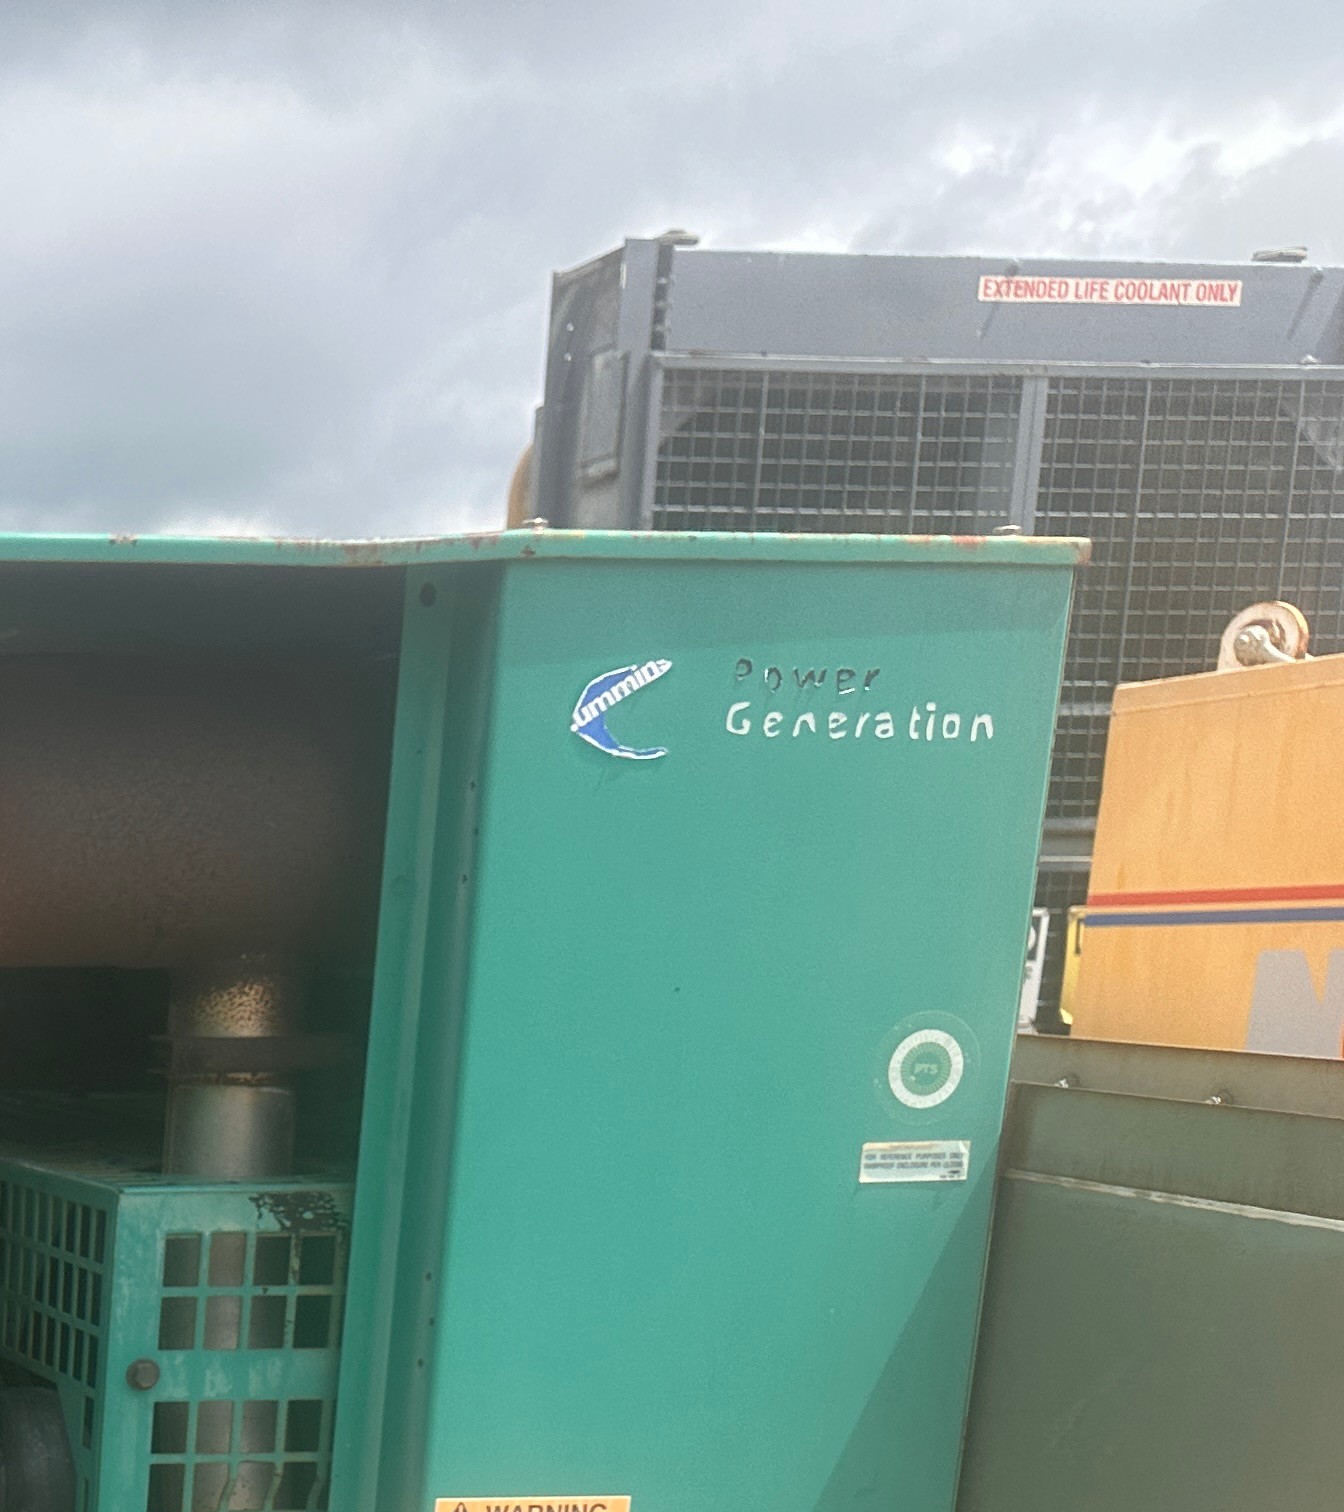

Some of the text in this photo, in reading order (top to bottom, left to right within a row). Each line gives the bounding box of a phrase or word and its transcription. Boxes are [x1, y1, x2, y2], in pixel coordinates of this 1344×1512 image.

[983, 278, 1238, 303] EXTENDED LIFE COOLANT ONLY
[735, 658, 880, 695] Power
[726, 701, 994, 742] Generation
